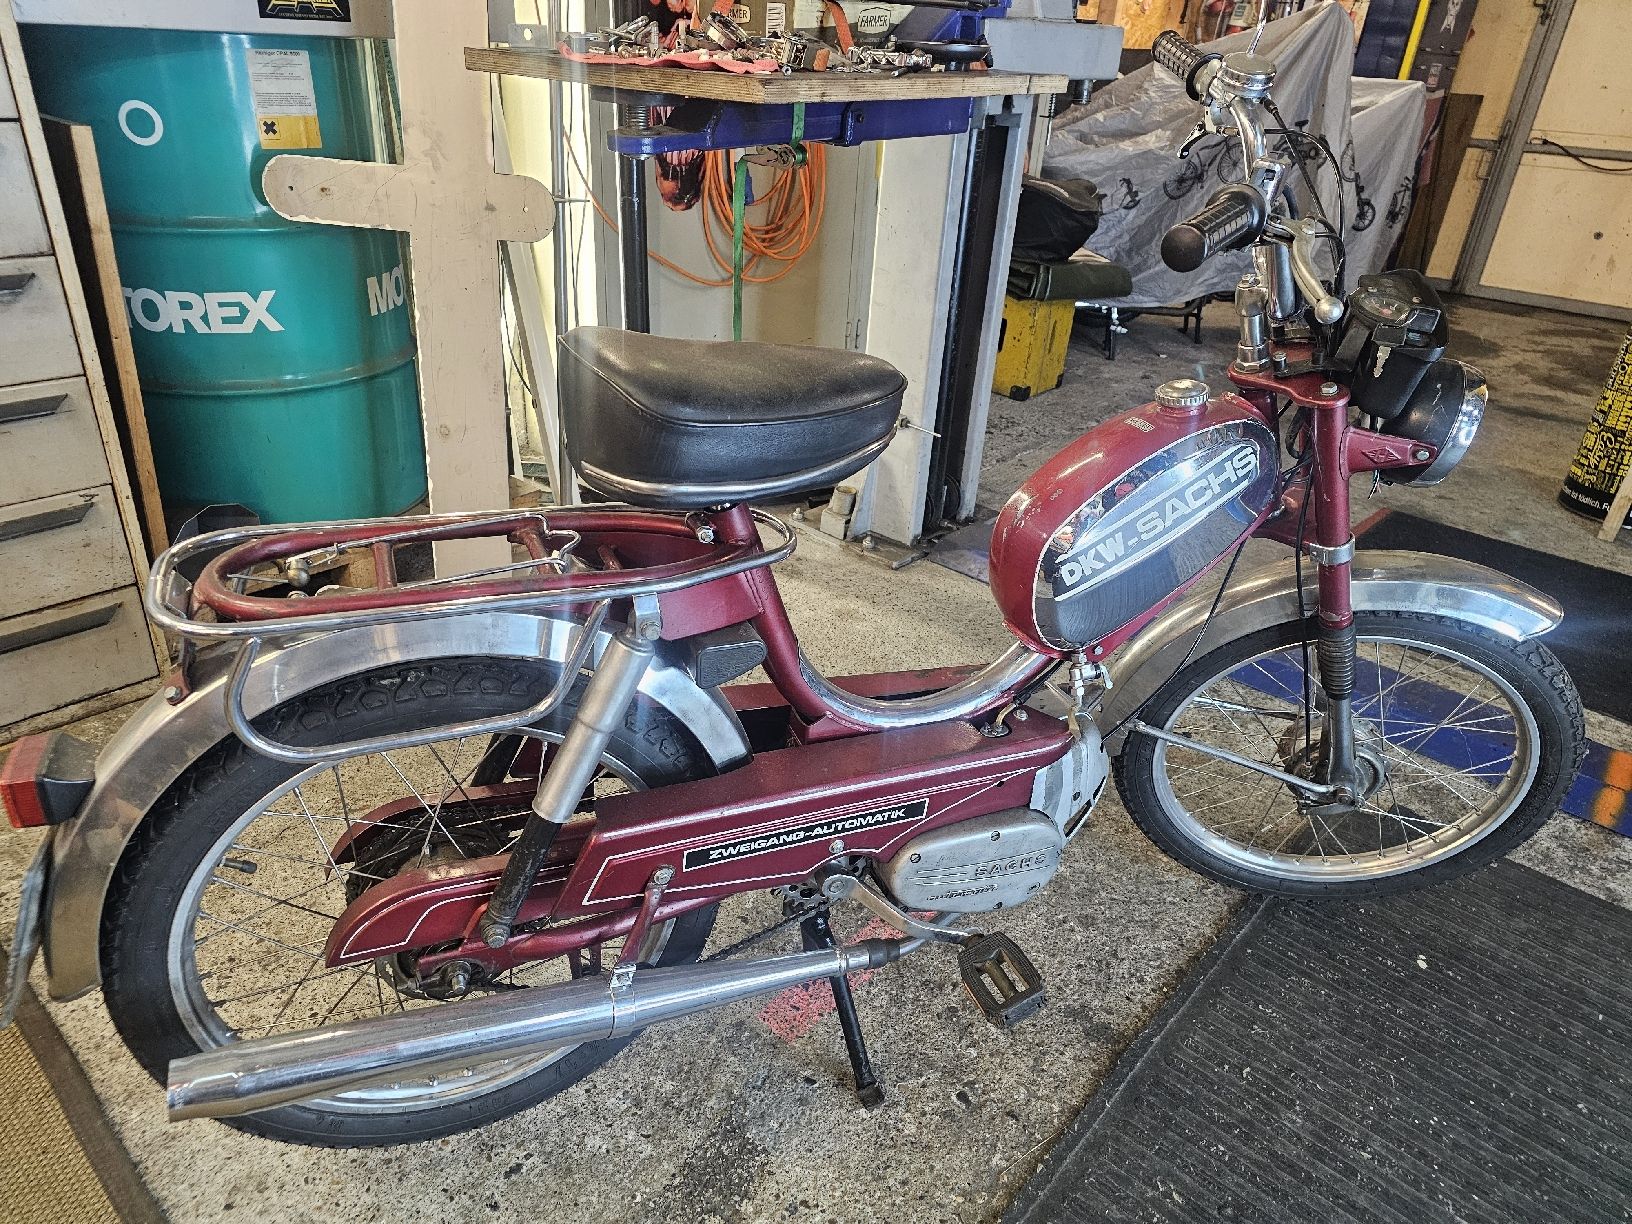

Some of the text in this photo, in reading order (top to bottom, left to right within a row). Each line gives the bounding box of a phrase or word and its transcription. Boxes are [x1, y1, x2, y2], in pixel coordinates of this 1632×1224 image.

[860, 15, 888, 28] FARMER
[366, 264, 406, 317] MO
[1060, 445, 1258, 587] DKW-SACHS
[708, 807, 907, 861] ZWEIGANG-AUTOMATIK
